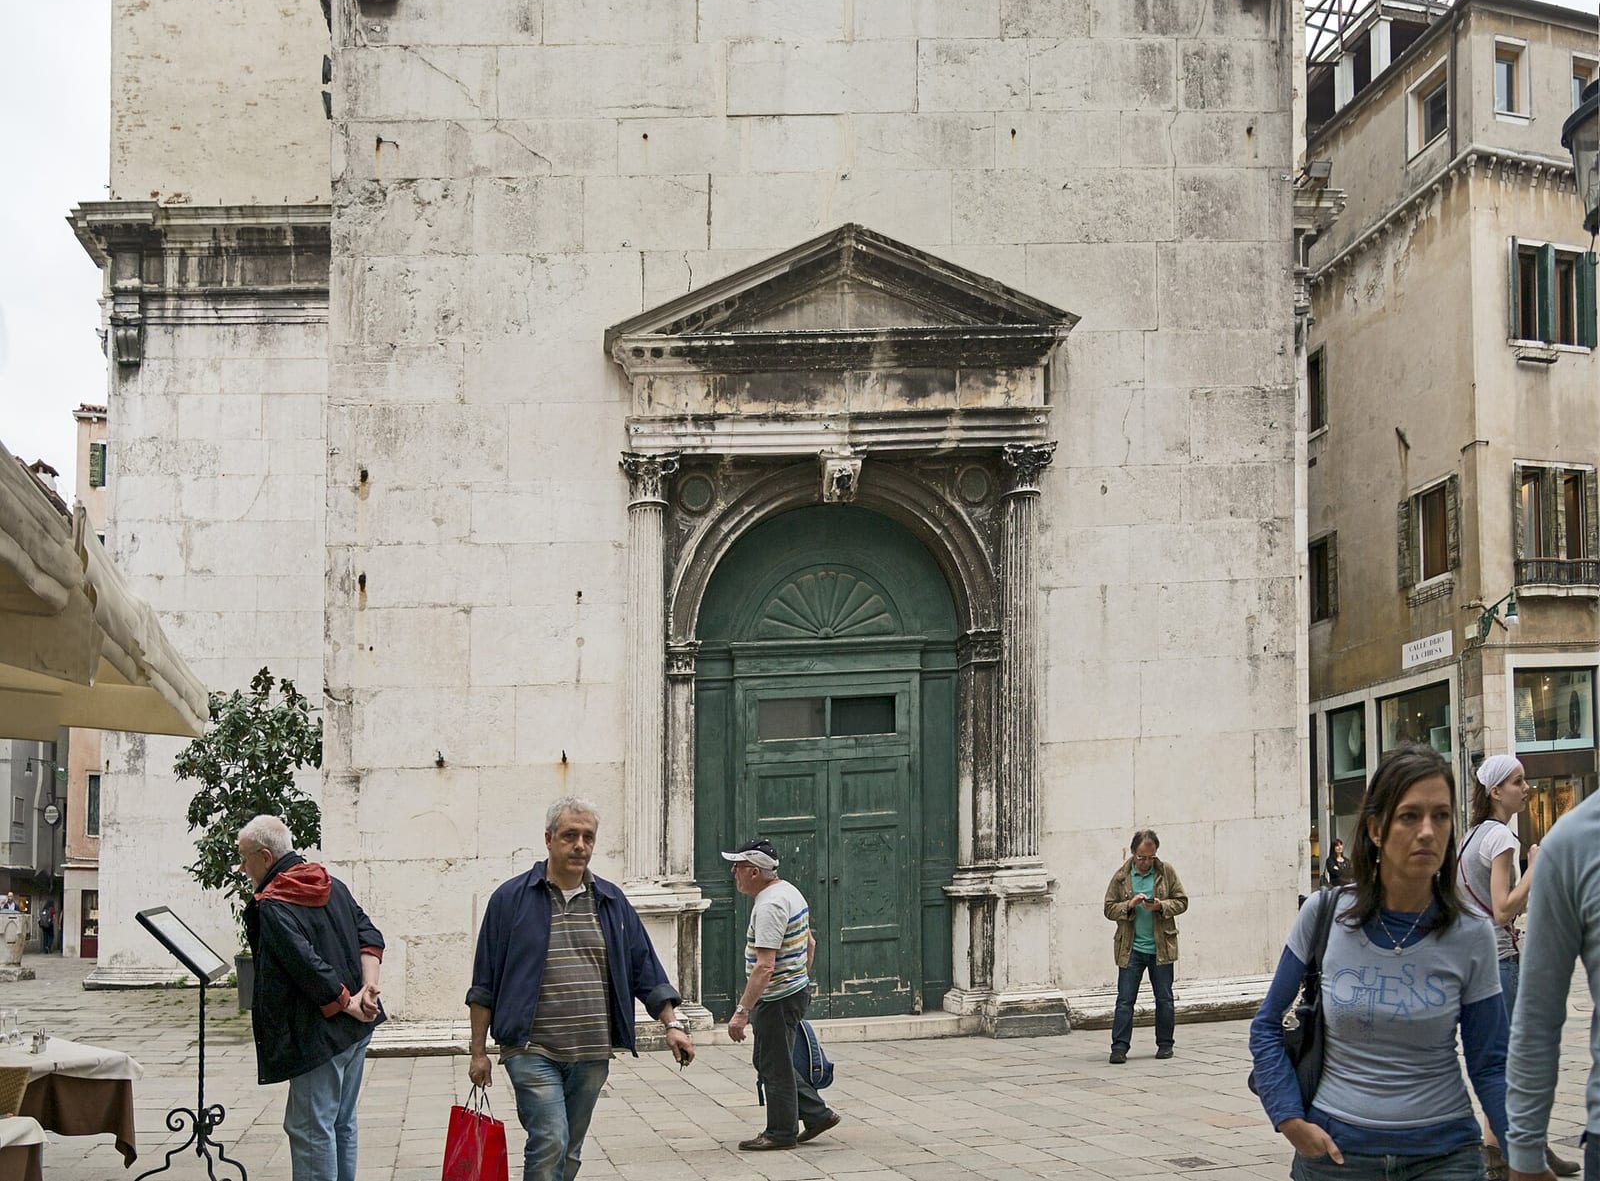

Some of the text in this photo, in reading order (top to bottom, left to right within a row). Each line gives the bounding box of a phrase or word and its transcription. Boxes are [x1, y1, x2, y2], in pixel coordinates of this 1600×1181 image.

[1408, 641, 1428, 652] CALLE
[1411, 647, 1442, 662] LA CHIESA
